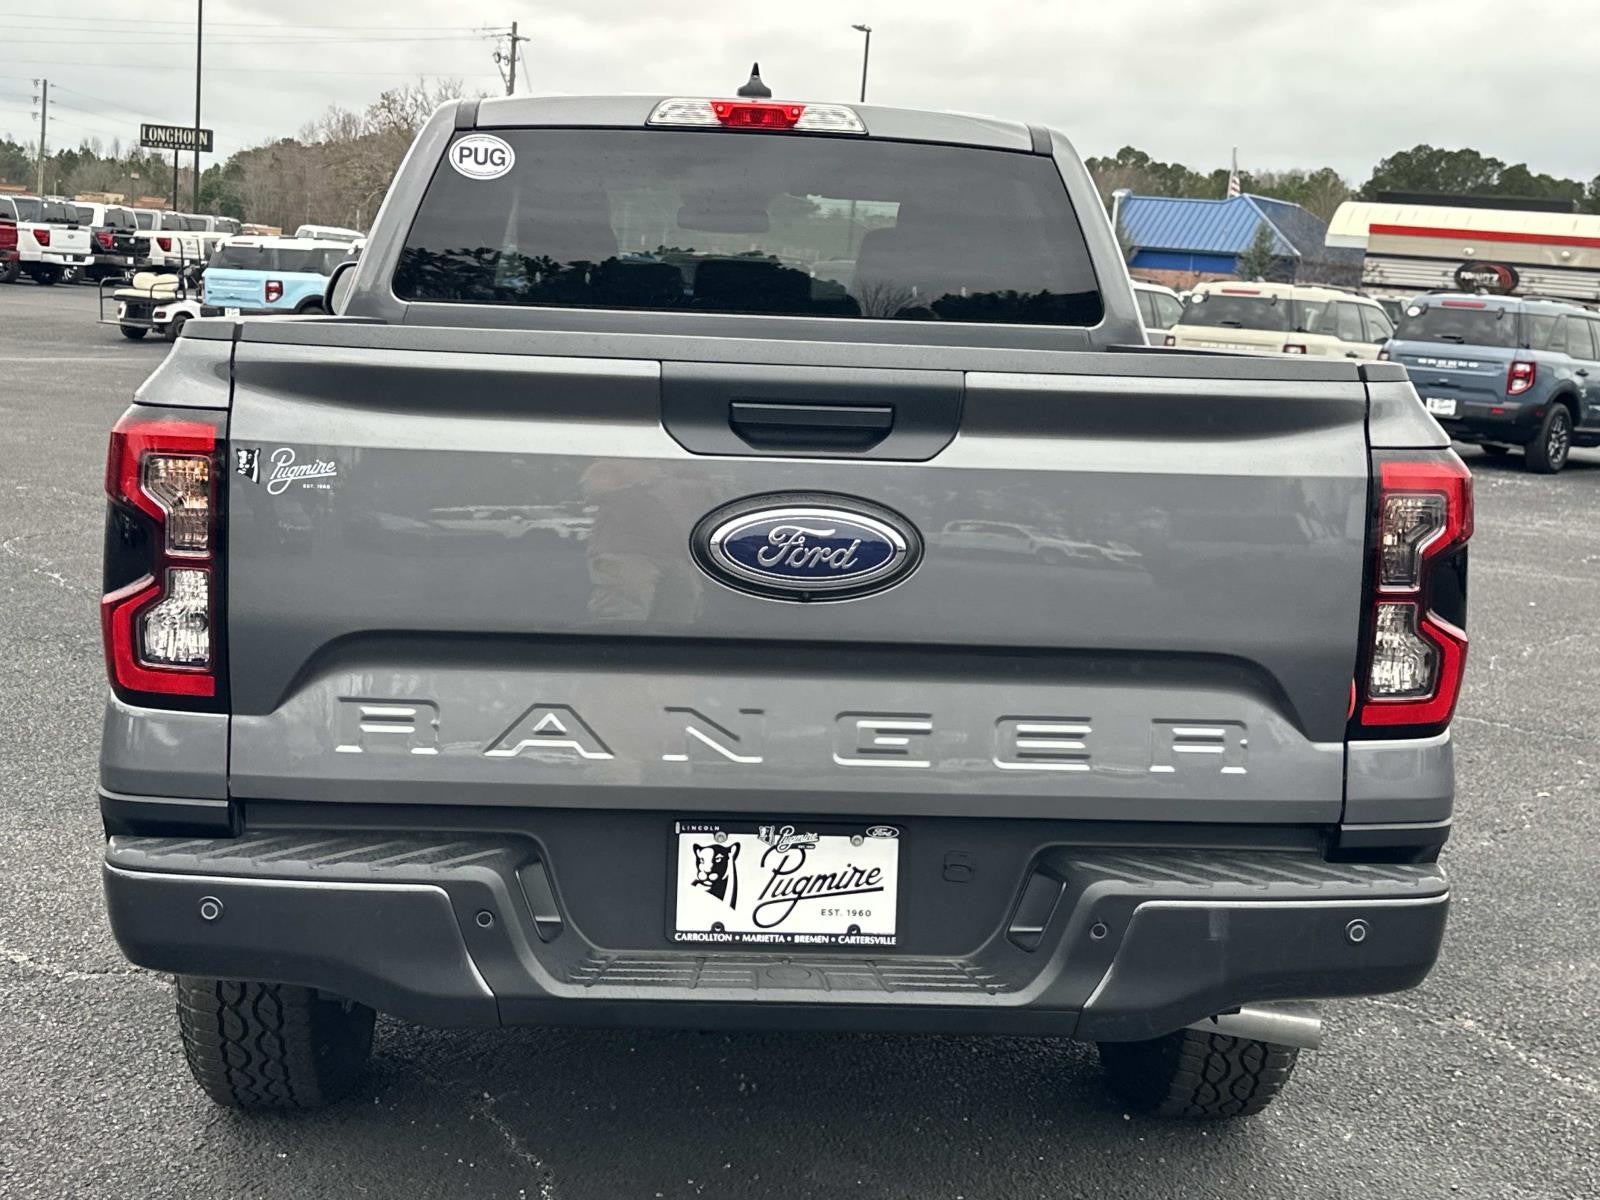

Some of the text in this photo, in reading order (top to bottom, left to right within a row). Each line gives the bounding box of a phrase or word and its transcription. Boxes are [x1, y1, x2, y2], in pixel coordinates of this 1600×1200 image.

[458, 146, 506, 167] PUG
[267, 447, 337, 495] Pugmire
[757, 525, 862, 569] Ford
[335, 697, 1248, 775] RANGER
[752, 844, 884, 929] Pugmire
[820, 908, 872, 917] EST. 1960
[674, 932, 897, 945] CARROLLTON MARIETTA BREMEN CARTERSVILLE
